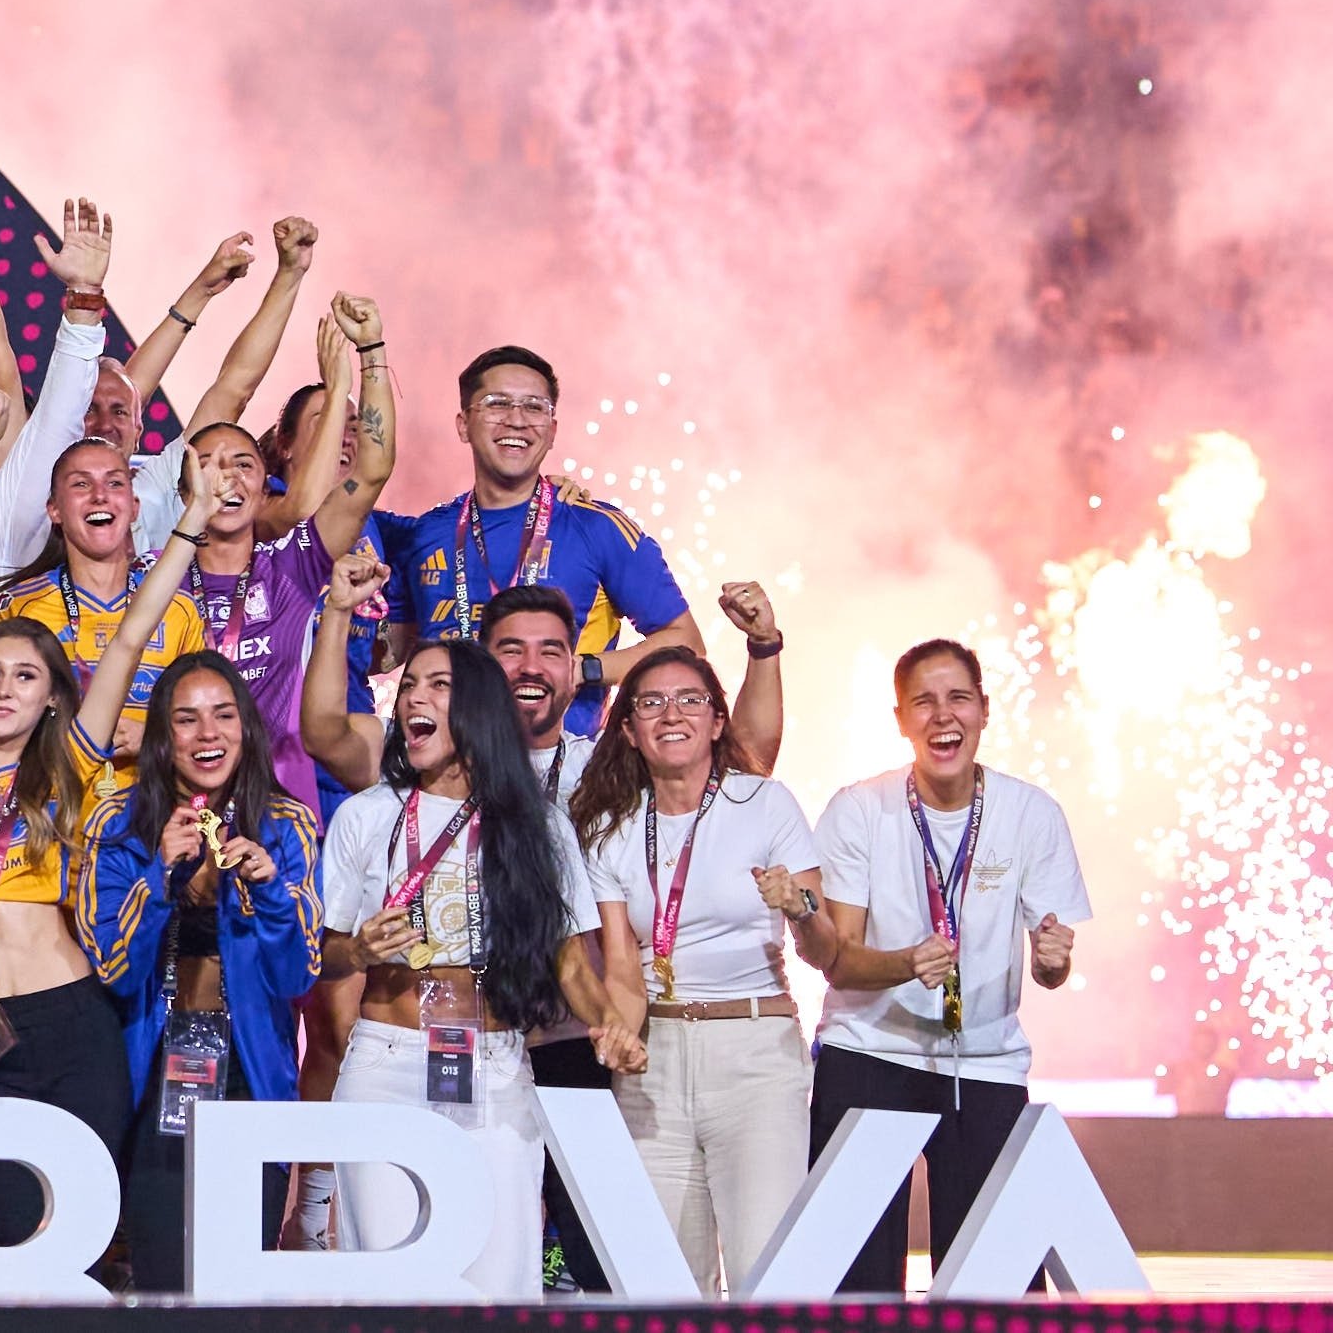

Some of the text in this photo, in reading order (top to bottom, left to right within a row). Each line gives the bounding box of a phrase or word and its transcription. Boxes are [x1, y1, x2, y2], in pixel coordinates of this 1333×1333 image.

[236, 578, 248, 599] LIGA
[456, 584, 469, 612] BBVA
[66, 594, 79, 618] BBVA
[973, 797, 983, 828] BBVA
[408, 820, 419, 844] LIGA
[446, 816, 465, 837] LIGA
[467, 852, 478, 879] LIGA
[468, 893, 482, 926] BBVA
[442, 1065, 459, 1076] 013
